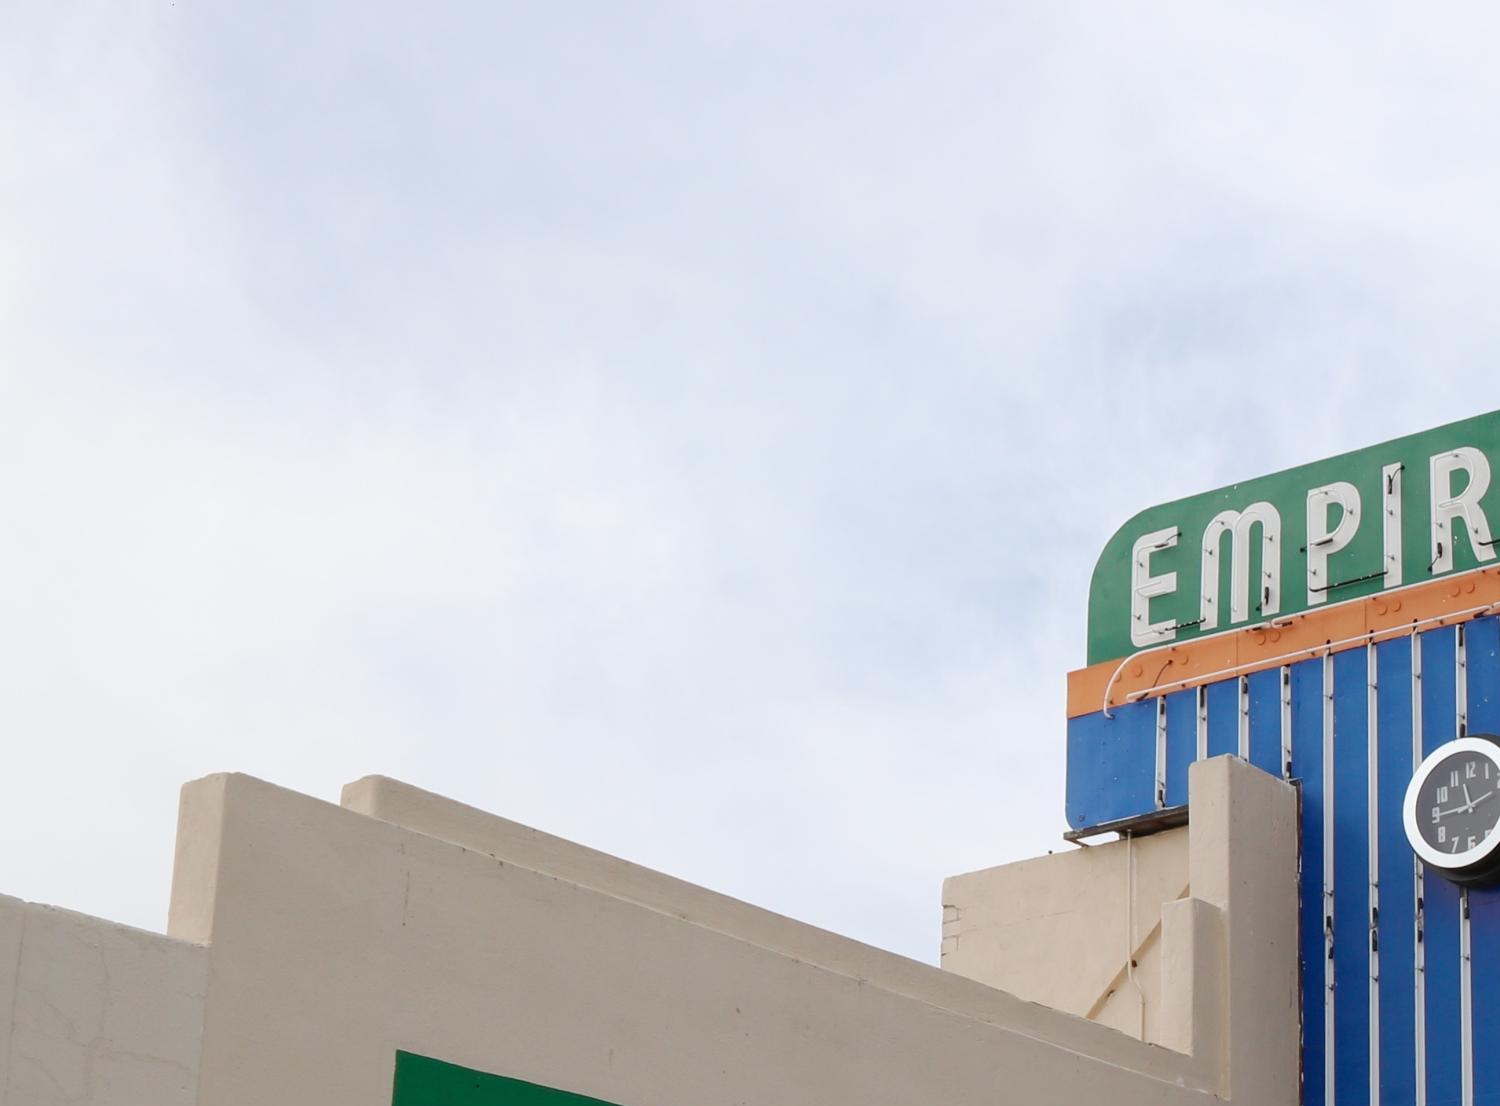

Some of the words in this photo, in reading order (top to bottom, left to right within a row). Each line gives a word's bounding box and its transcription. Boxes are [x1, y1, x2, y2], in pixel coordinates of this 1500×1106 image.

[1466, 761, 1476, 779] 12
[1484, 763, 1490, 779] 1
[1450, 770, 1459, 788] 11
[1436, 786, 1448, 803] 10
[1432, 806, 1440, 823] 9
[1438, 826, 1446, 843] 8
[1451, 836, 1460, 853] 7
